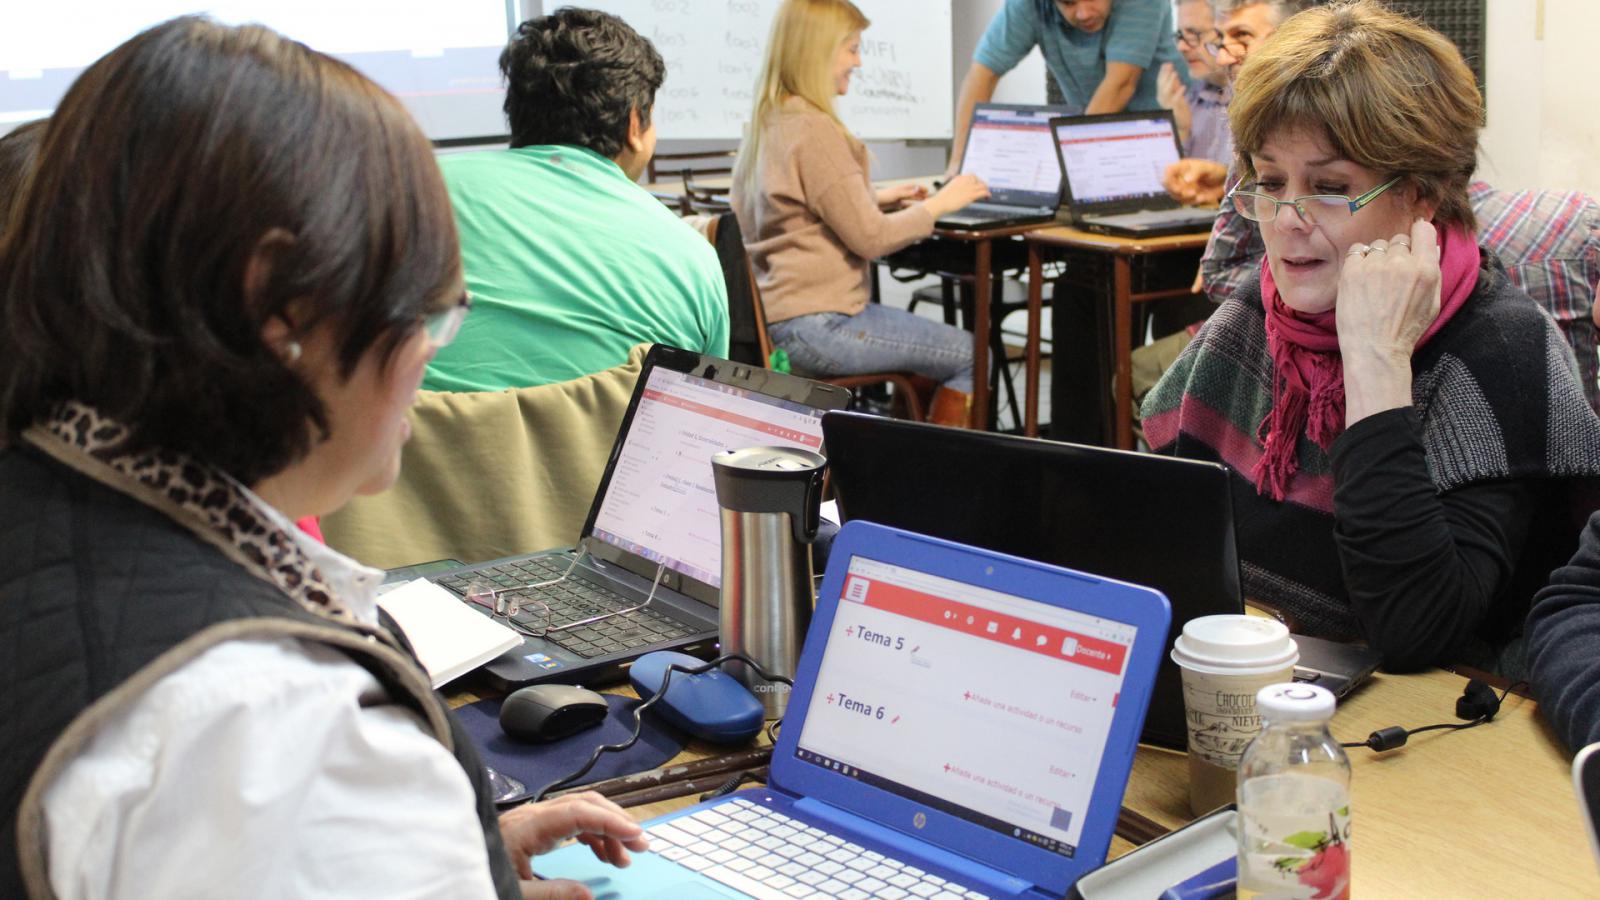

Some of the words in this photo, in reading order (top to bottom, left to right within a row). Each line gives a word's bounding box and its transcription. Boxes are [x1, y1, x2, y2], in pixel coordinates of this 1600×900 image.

[857, 625, 891, 647] Tema
[895, 637, 905, 651] 5
[838, 692, 872, 716] Tema
[876, 706, 886, 720] 6
[1216, 690, 1257, 708] CHOCOL
